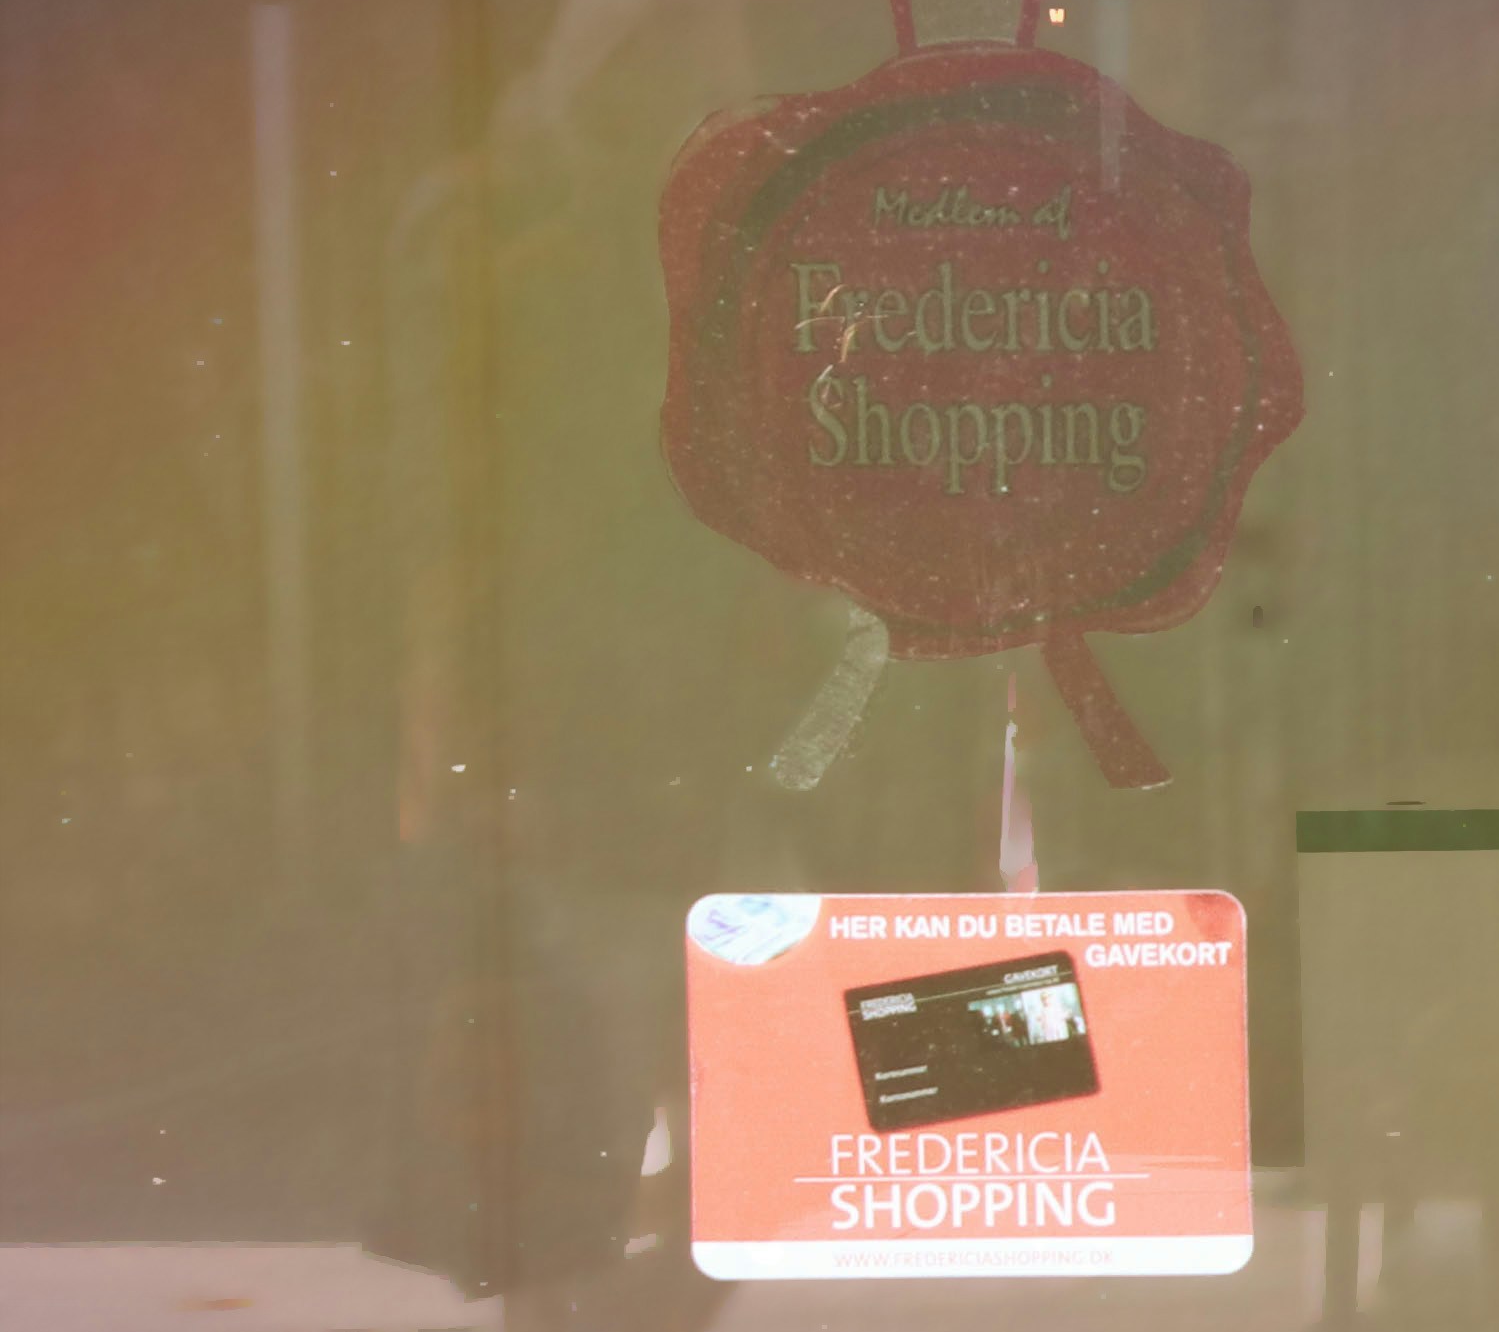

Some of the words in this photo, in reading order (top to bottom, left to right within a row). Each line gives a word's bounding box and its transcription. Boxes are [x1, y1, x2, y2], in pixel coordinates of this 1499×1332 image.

[791, 259, 1156, 356] Fredericia
[808, 373, 1147, 493] Shopping
[830, 915, 887, 941] HER
[895, 915, 952, 939] KAN
[958, 914, 997, 938] DU
[1005, 913, 1106, 938] BETALE
[1113, 910, 1173, 936] MED
[1084, 941, 1231, 968] GAVEKORT
[830, 1132, 1110, 1176] FREDERICIA
[830, 1181, 1115, 1230] SHOPPING
